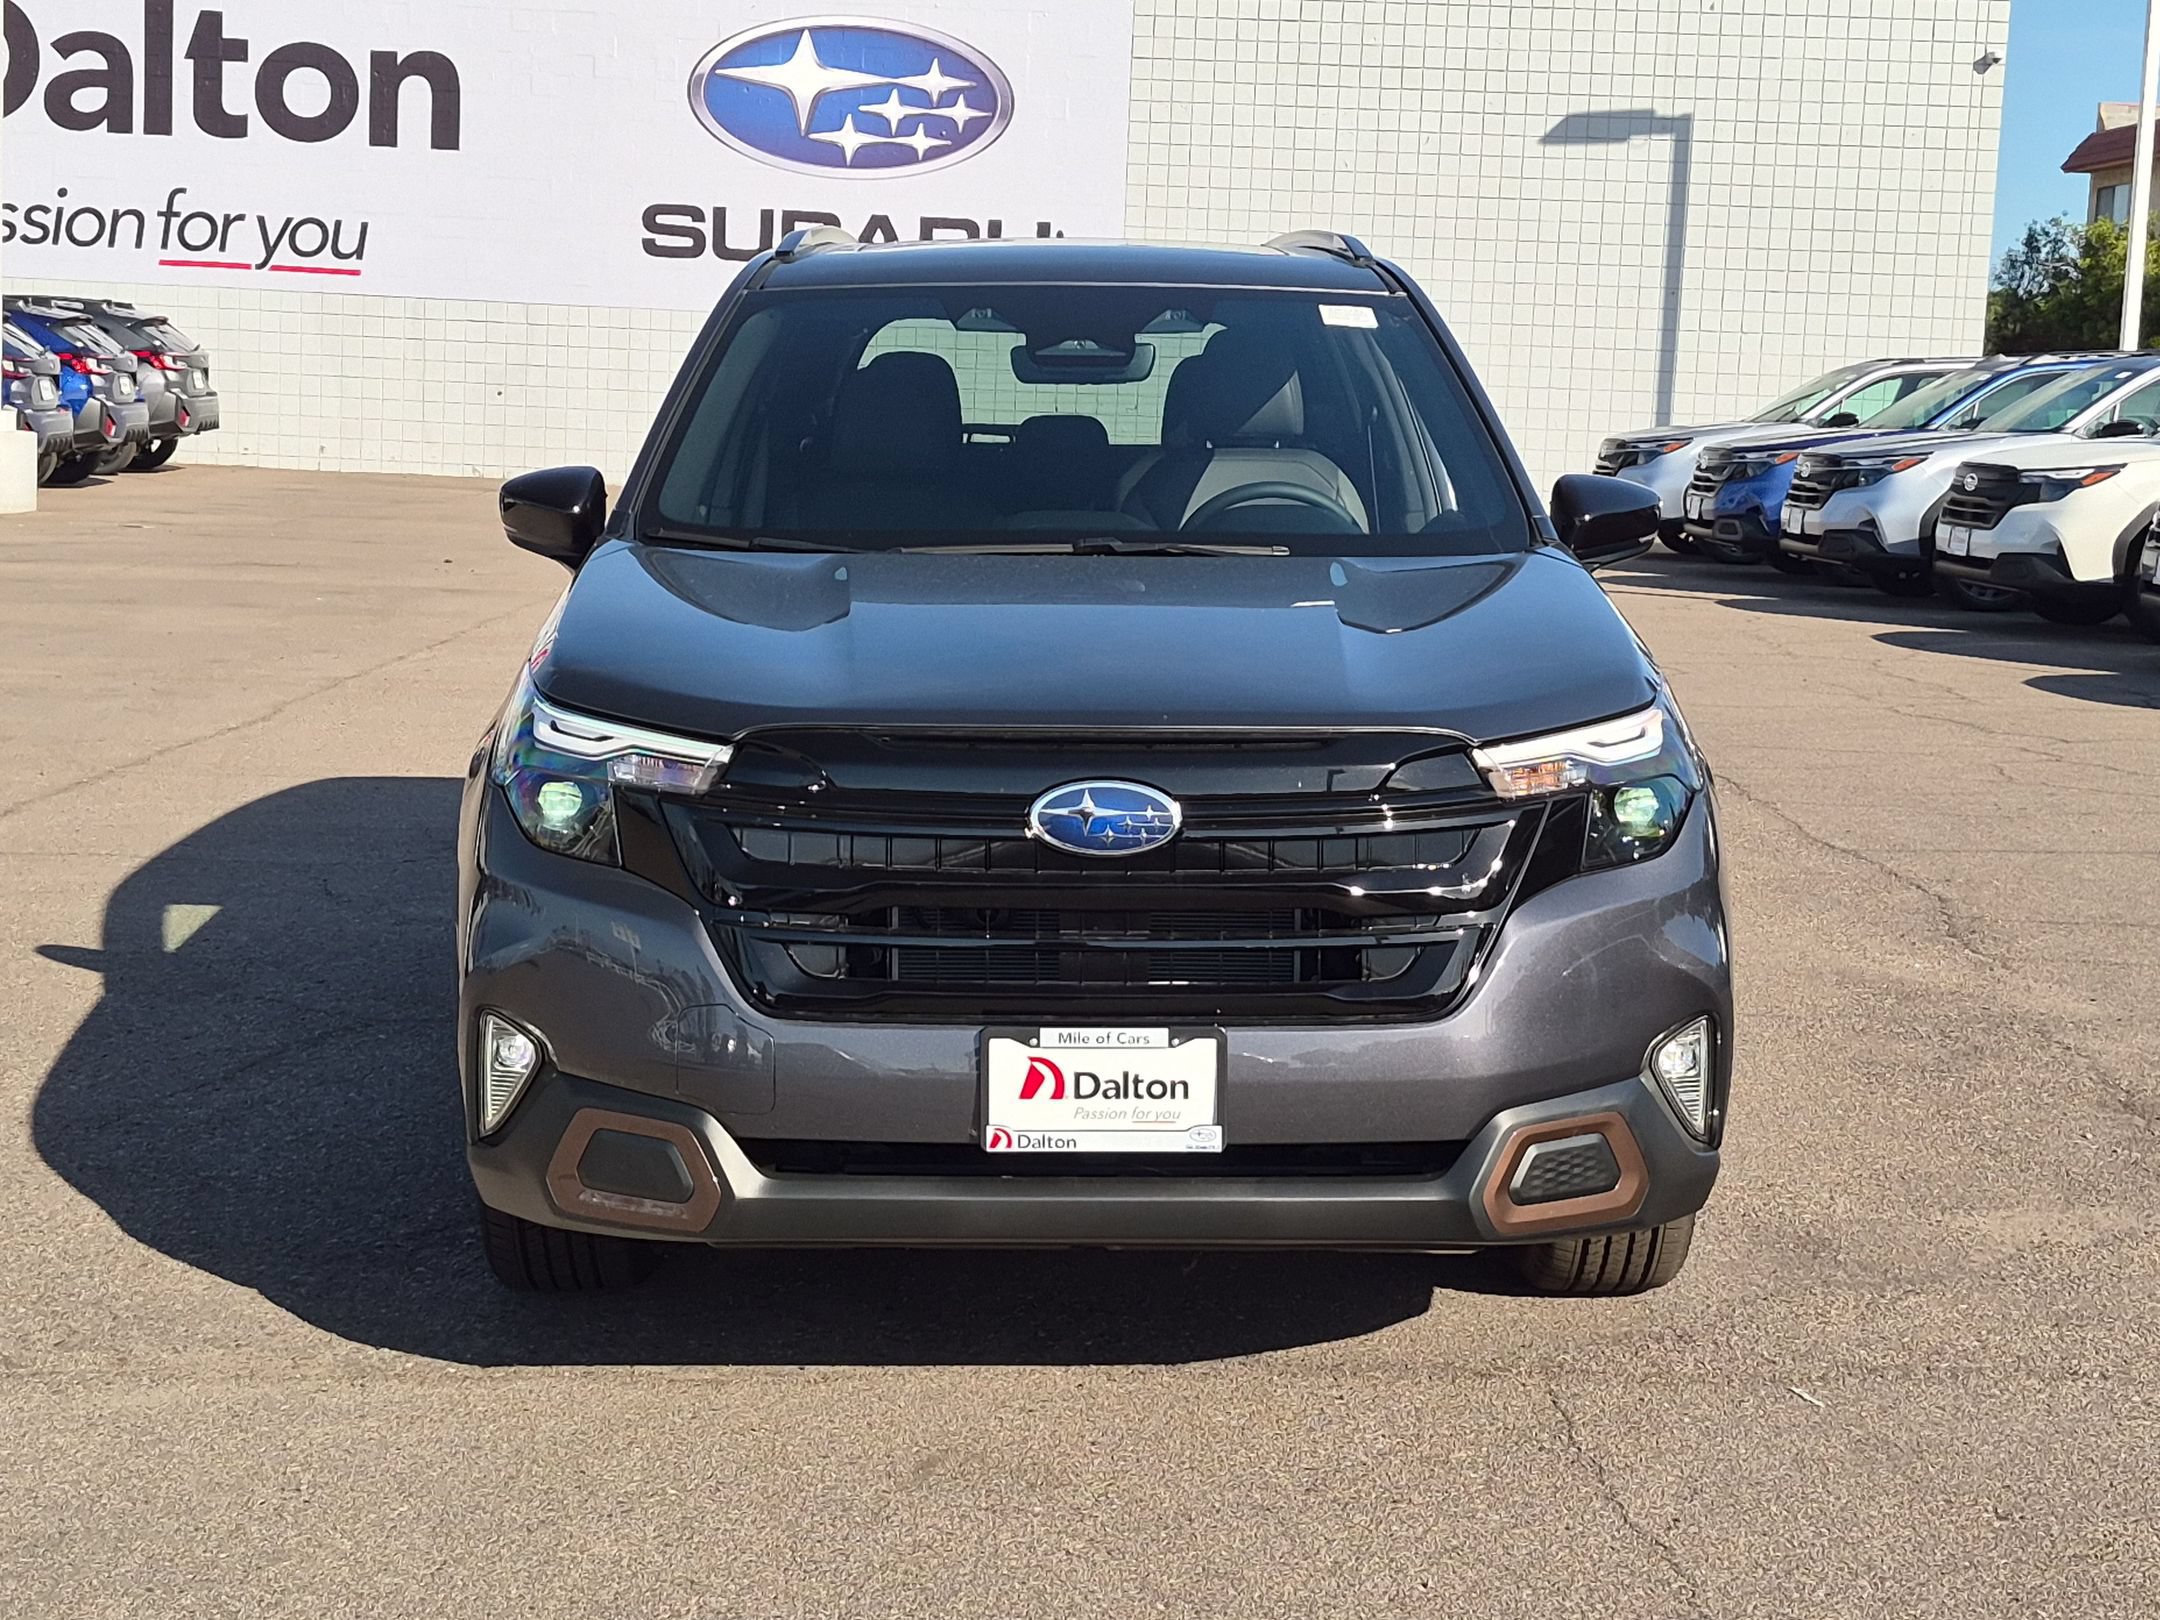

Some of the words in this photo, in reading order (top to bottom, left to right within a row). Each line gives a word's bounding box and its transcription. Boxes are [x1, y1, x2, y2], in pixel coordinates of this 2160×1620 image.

[157, 187, 246, 253] for
[255, 212, 368, 271] you
[1058, 1032, 1090, 1045] Mile
[1096, 1031, 1112, 1045] of
[1117, 1032, 1150, 1045] Cars
[1073, 1071, 1189, 1100] Dalton
[1073, 1106, 1128, 1120] Passion
[1131, 1106, 1151, 1120] for
[1154, 1110, 1182, 1122] you
[1017, 1134, 1077, 1149] Dalton
